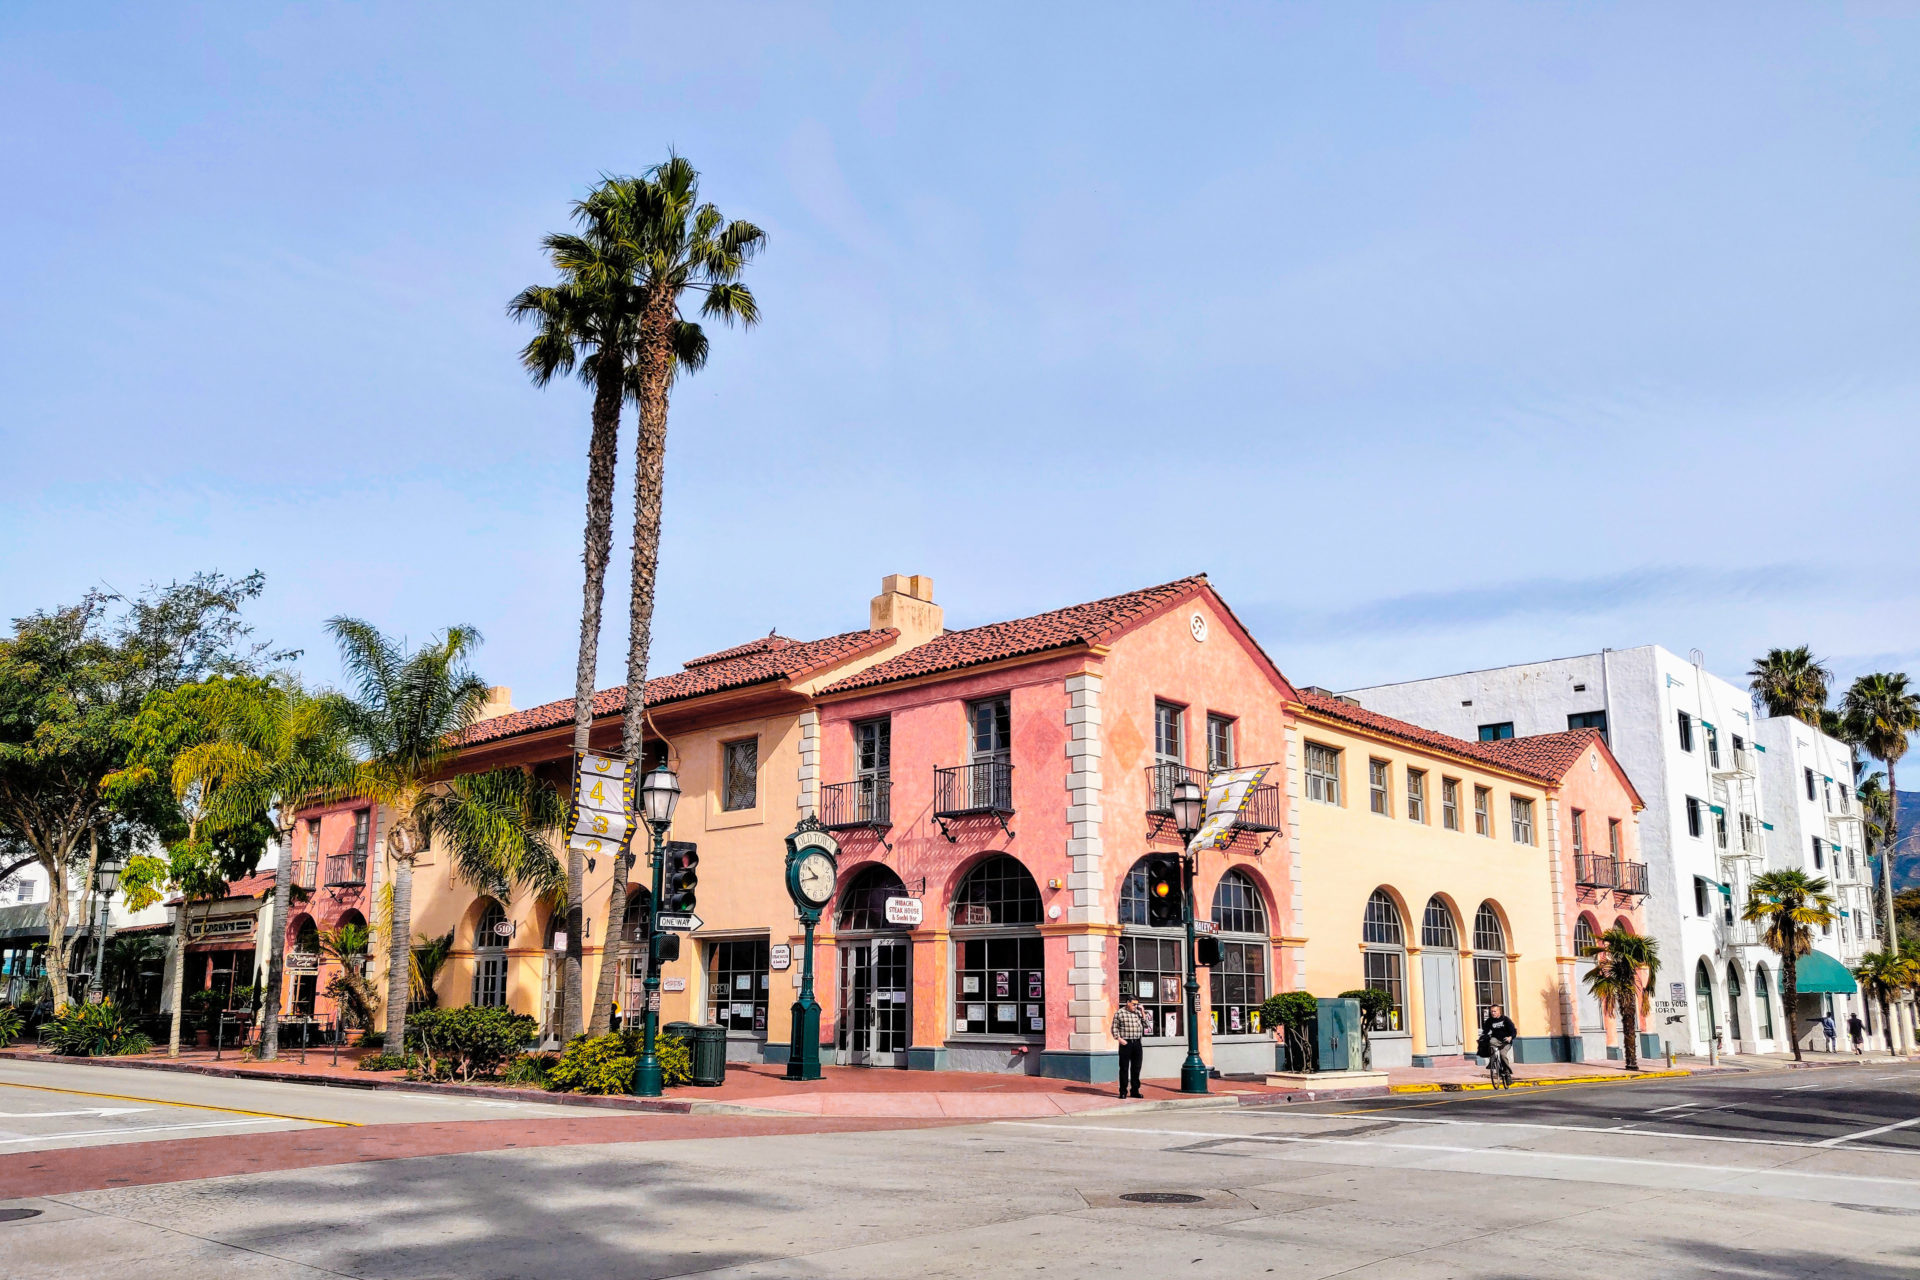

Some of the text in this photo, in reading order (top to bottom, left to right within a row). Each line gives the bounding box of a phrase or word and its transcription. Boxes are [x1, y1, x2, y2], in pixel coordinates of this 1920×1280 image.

[590, 781, 605, 806] 4
[592, 815, 609, 834] 3
[798, 833, 833, 849] OLD TOWN
[662, 918, 690, 926] ONE WAY
[497, 924, 511, 933] 510
[712, 984, 729, 994] OPEN
[1119, 982, 1132, 994] PEN
